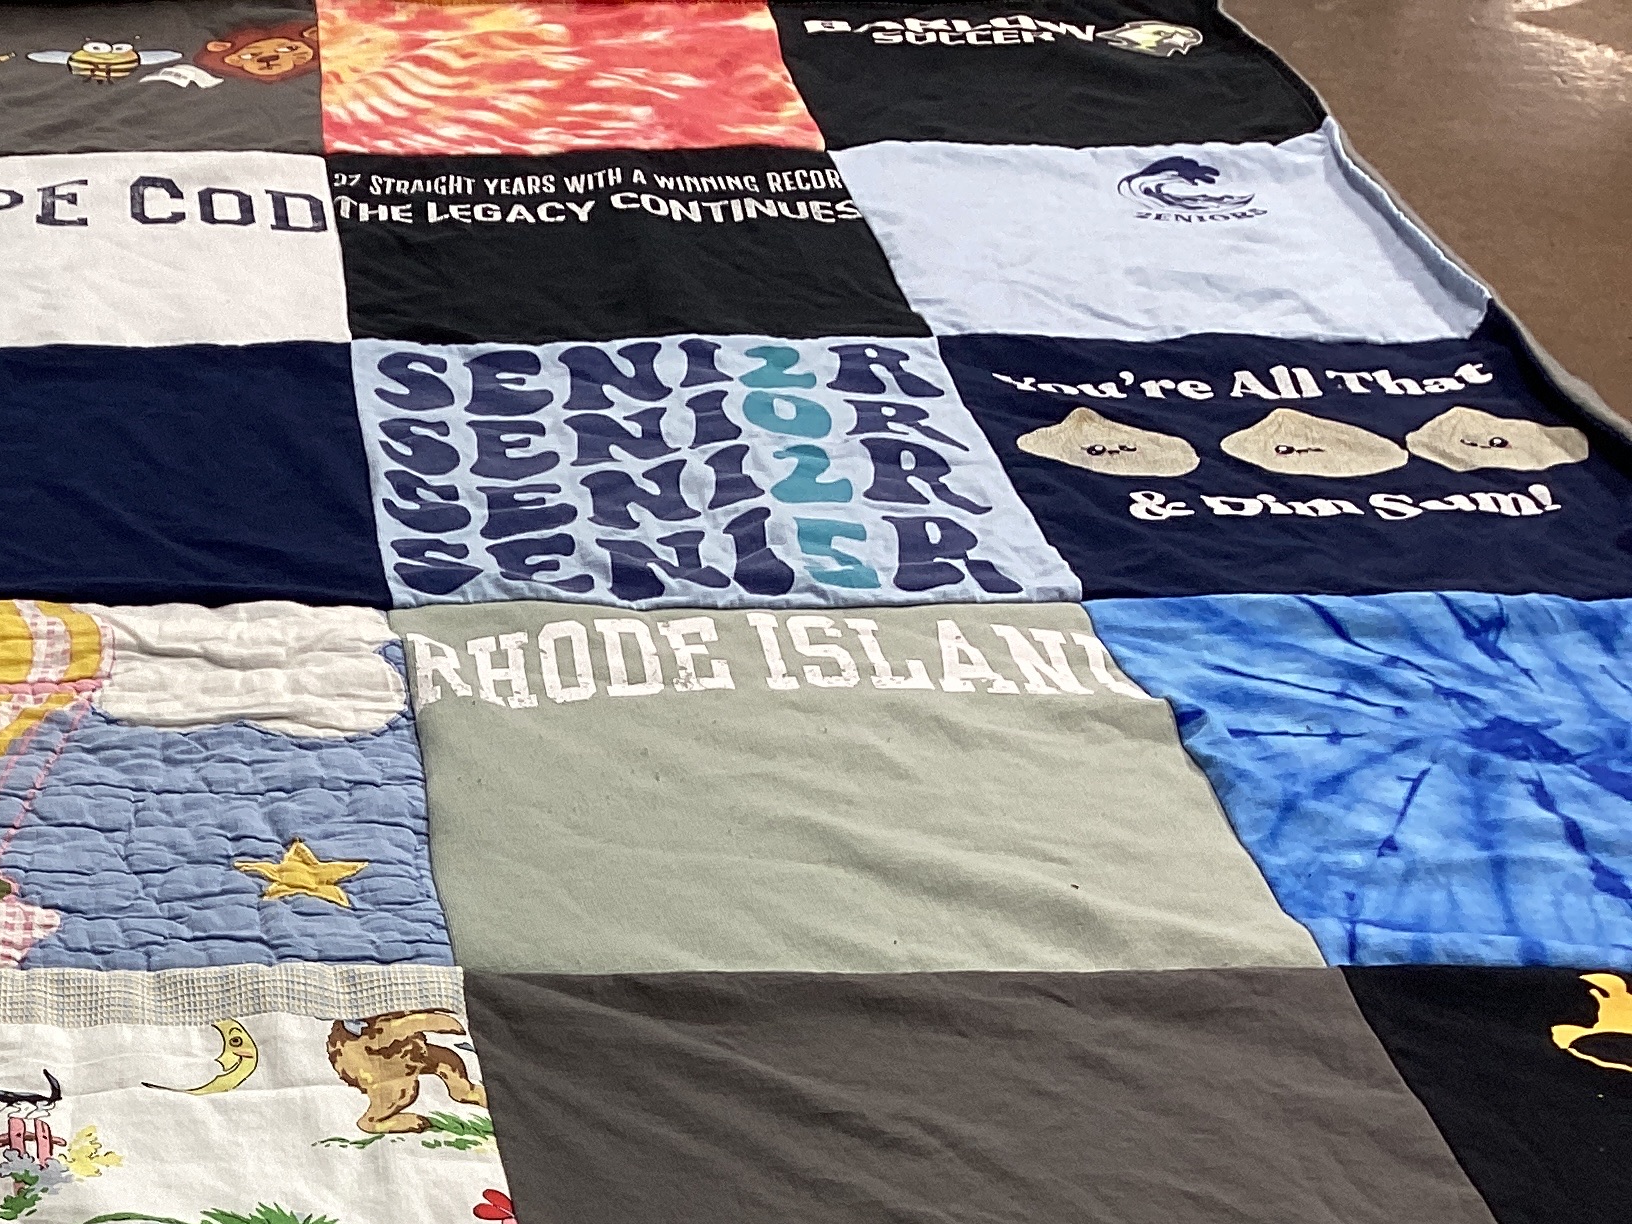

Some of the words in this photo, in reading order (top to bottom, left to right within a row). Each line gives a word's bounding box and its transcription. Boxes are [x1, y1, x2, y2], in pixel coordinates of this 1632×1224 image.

[872, 28, 1055, 45] SOCCER
[369, 174, 476, 196] STRAIGHT
[483, 174, 556, 196] YEARS
[564, 167, 622, 194] WITH
[631, 168, 647, 185] A
[653, 173, 760, 193] WINNING
[129, 176, 328, 233] COD
[334, 195, 413, 223] THE
[427, 200, 596, 223] LEGACY
[610, 192, 863, 223] CONTINUES
[992, 370, 1215, 400] You're
[1229, 364, 1320, 400] All
[1325, 361, 1494, 396] That
[1128, 490, 1195, 520] &
[1200, 493, 1366, 518] Dim
[406, 616, 736, 710] RHODE
